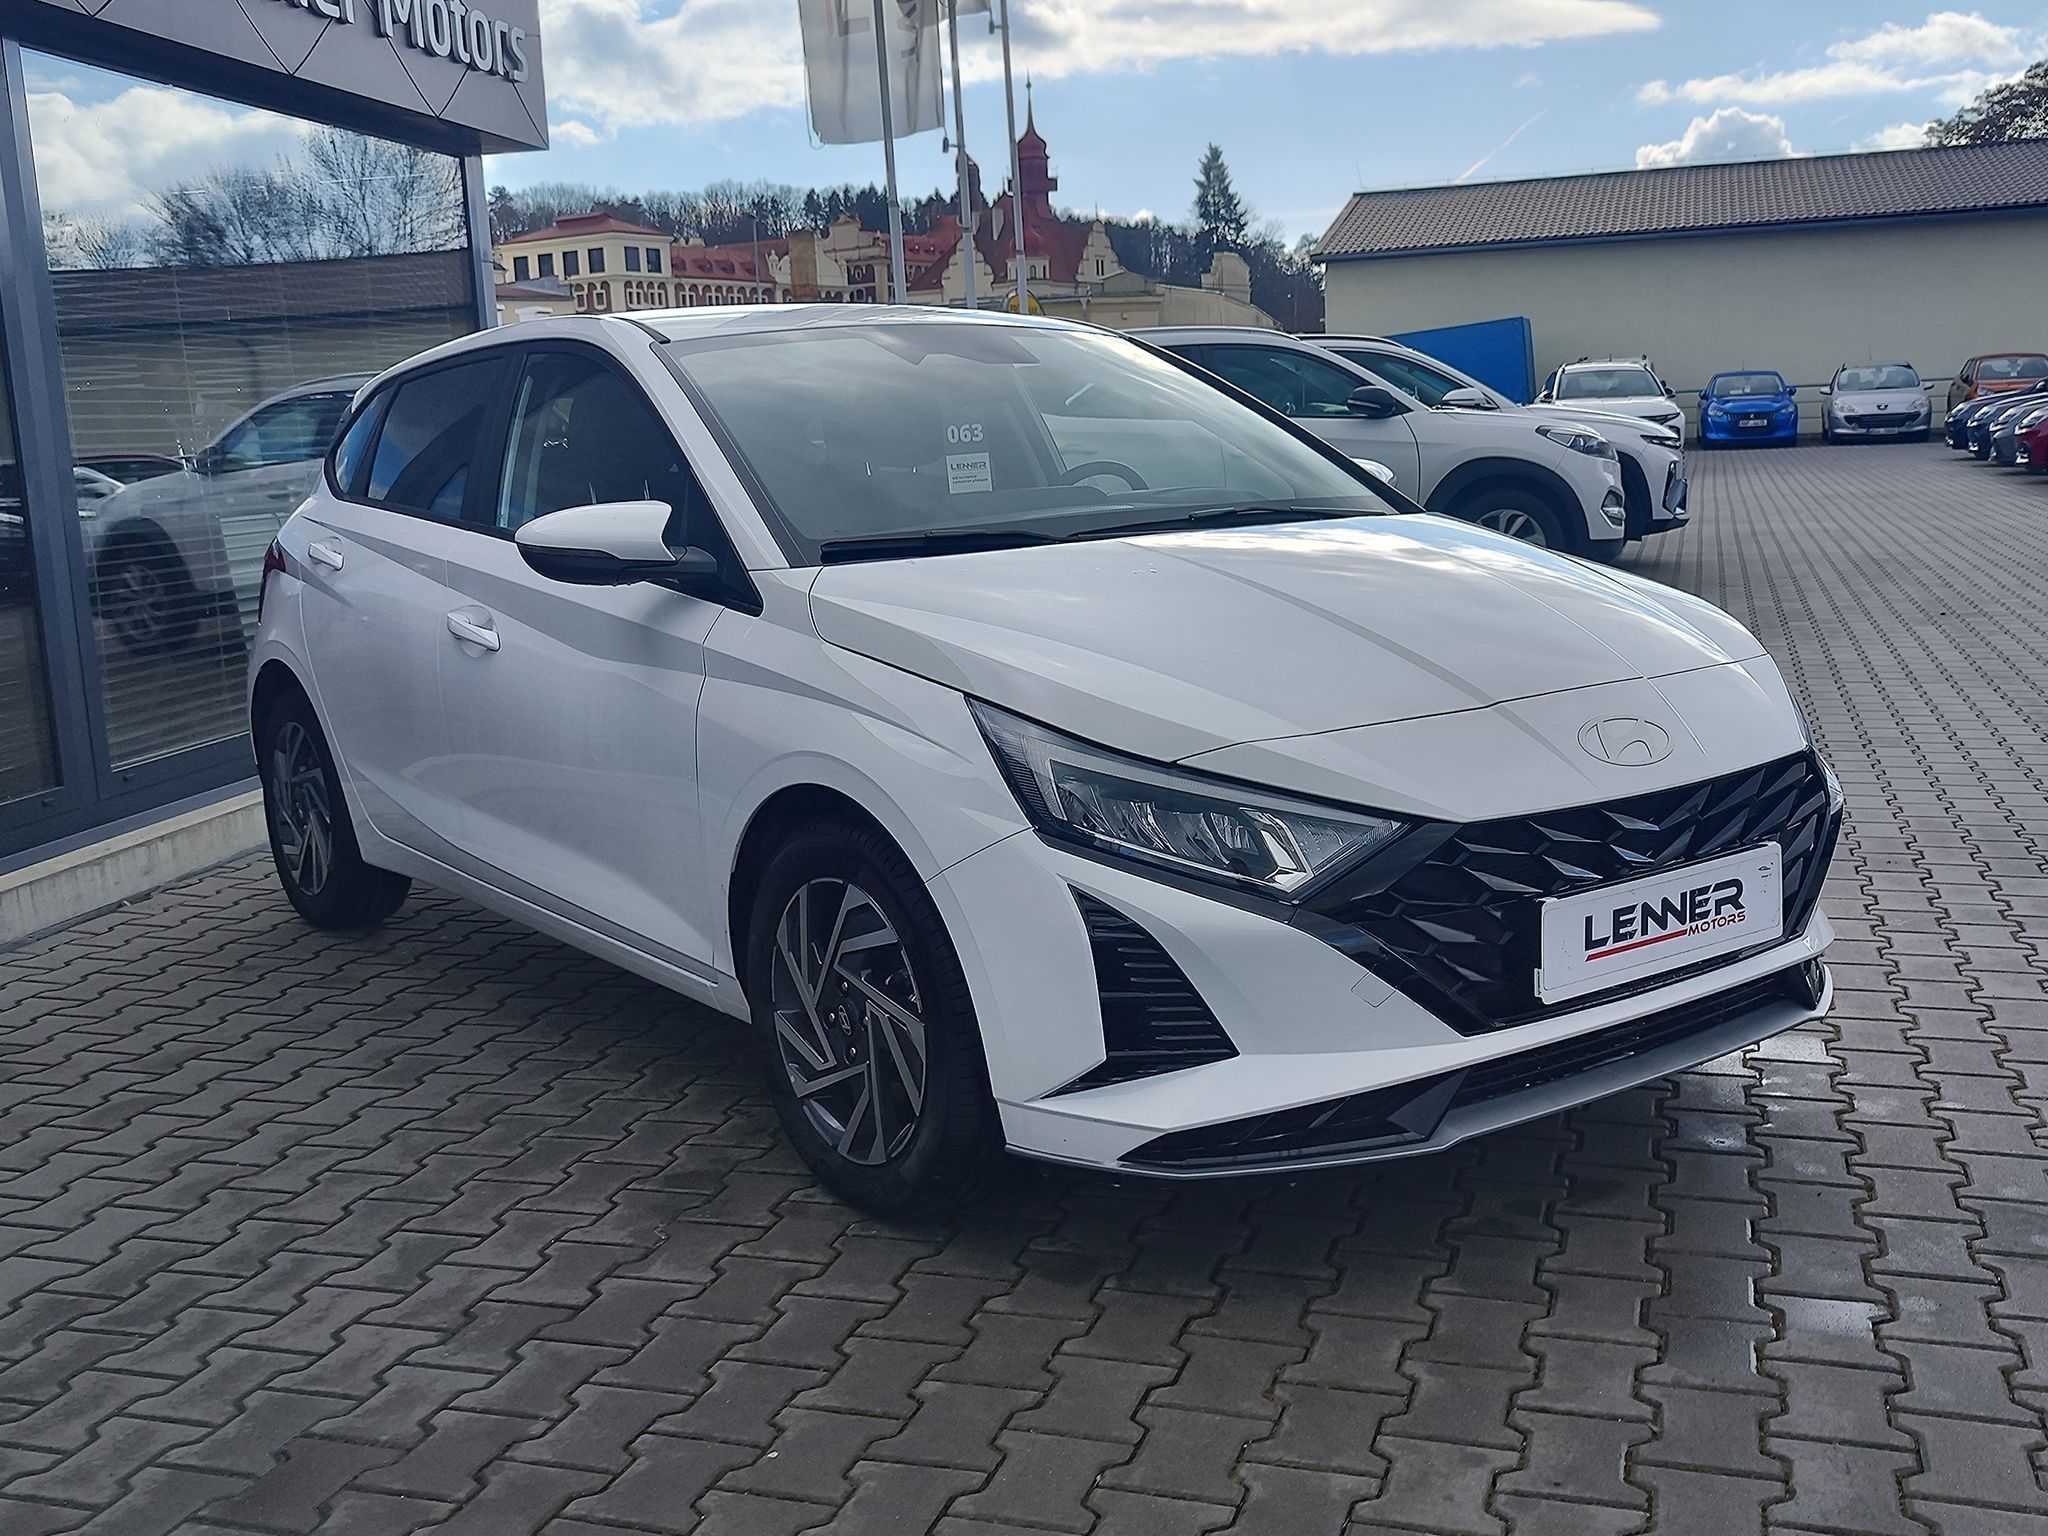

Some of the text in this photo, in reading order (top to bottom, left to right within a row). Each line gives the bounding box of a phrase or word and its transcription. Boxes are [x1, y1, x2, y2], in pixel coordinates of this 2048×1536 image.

[376, 0, 530, 83] Motors
[946, 423, 984, 444] 063
[1584, 878, 1746, 951] LENNER
[1687, 910, 1747, 937] MOTORS
